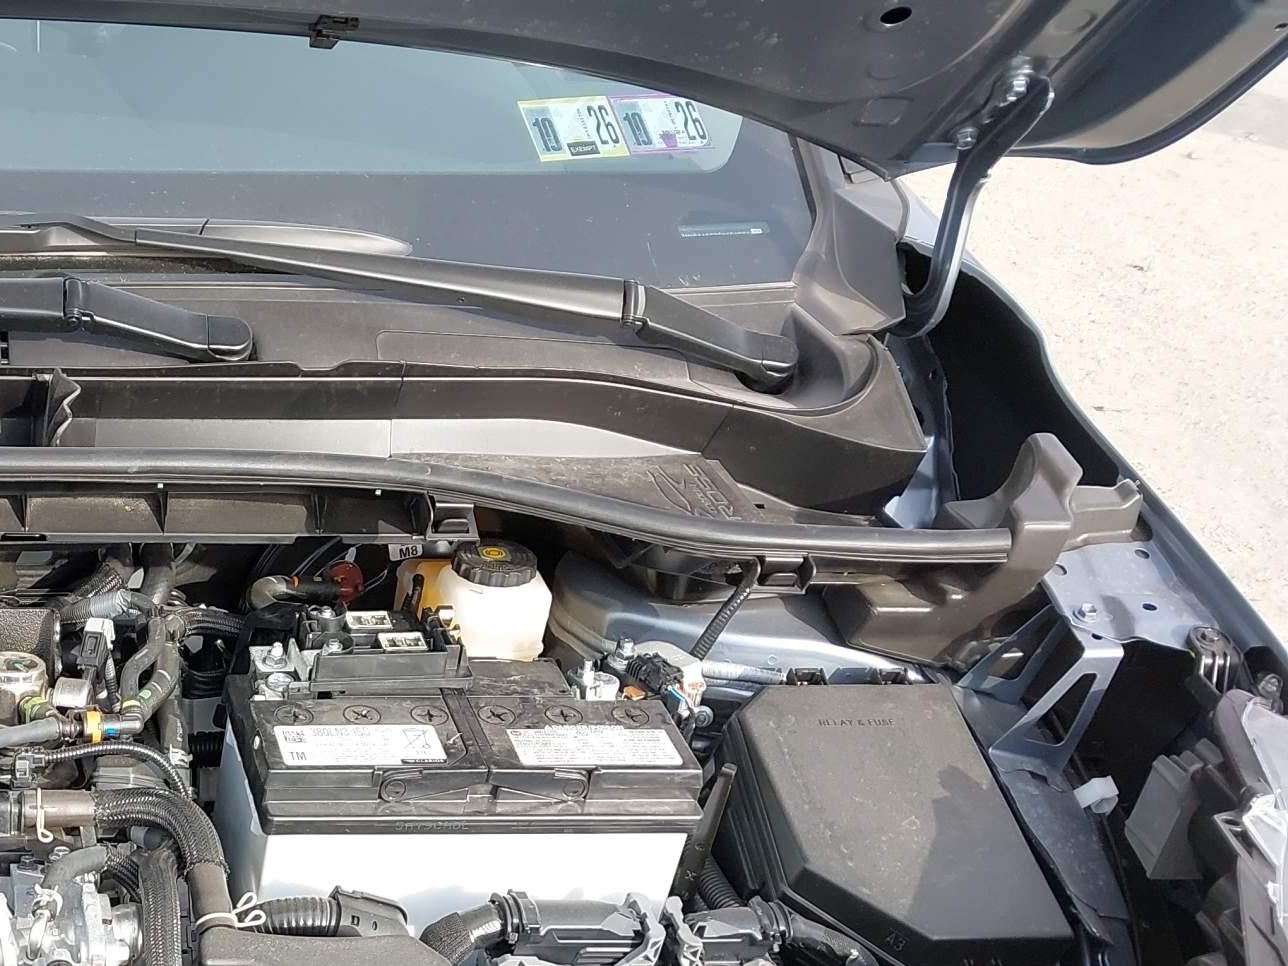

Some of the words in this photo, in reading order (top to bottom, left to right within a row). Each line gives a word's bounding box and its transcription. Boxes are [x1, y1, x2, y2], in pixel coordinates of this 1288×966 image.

[586, 104, 620, 144] 26
[674, 100, 707, 140] 26
[399, 545, 418, 558] M8
[817, 718, 853, 728] RELAY
[866, 718, 896, 728] FUSE
[289, 751, 308, 761] TM
